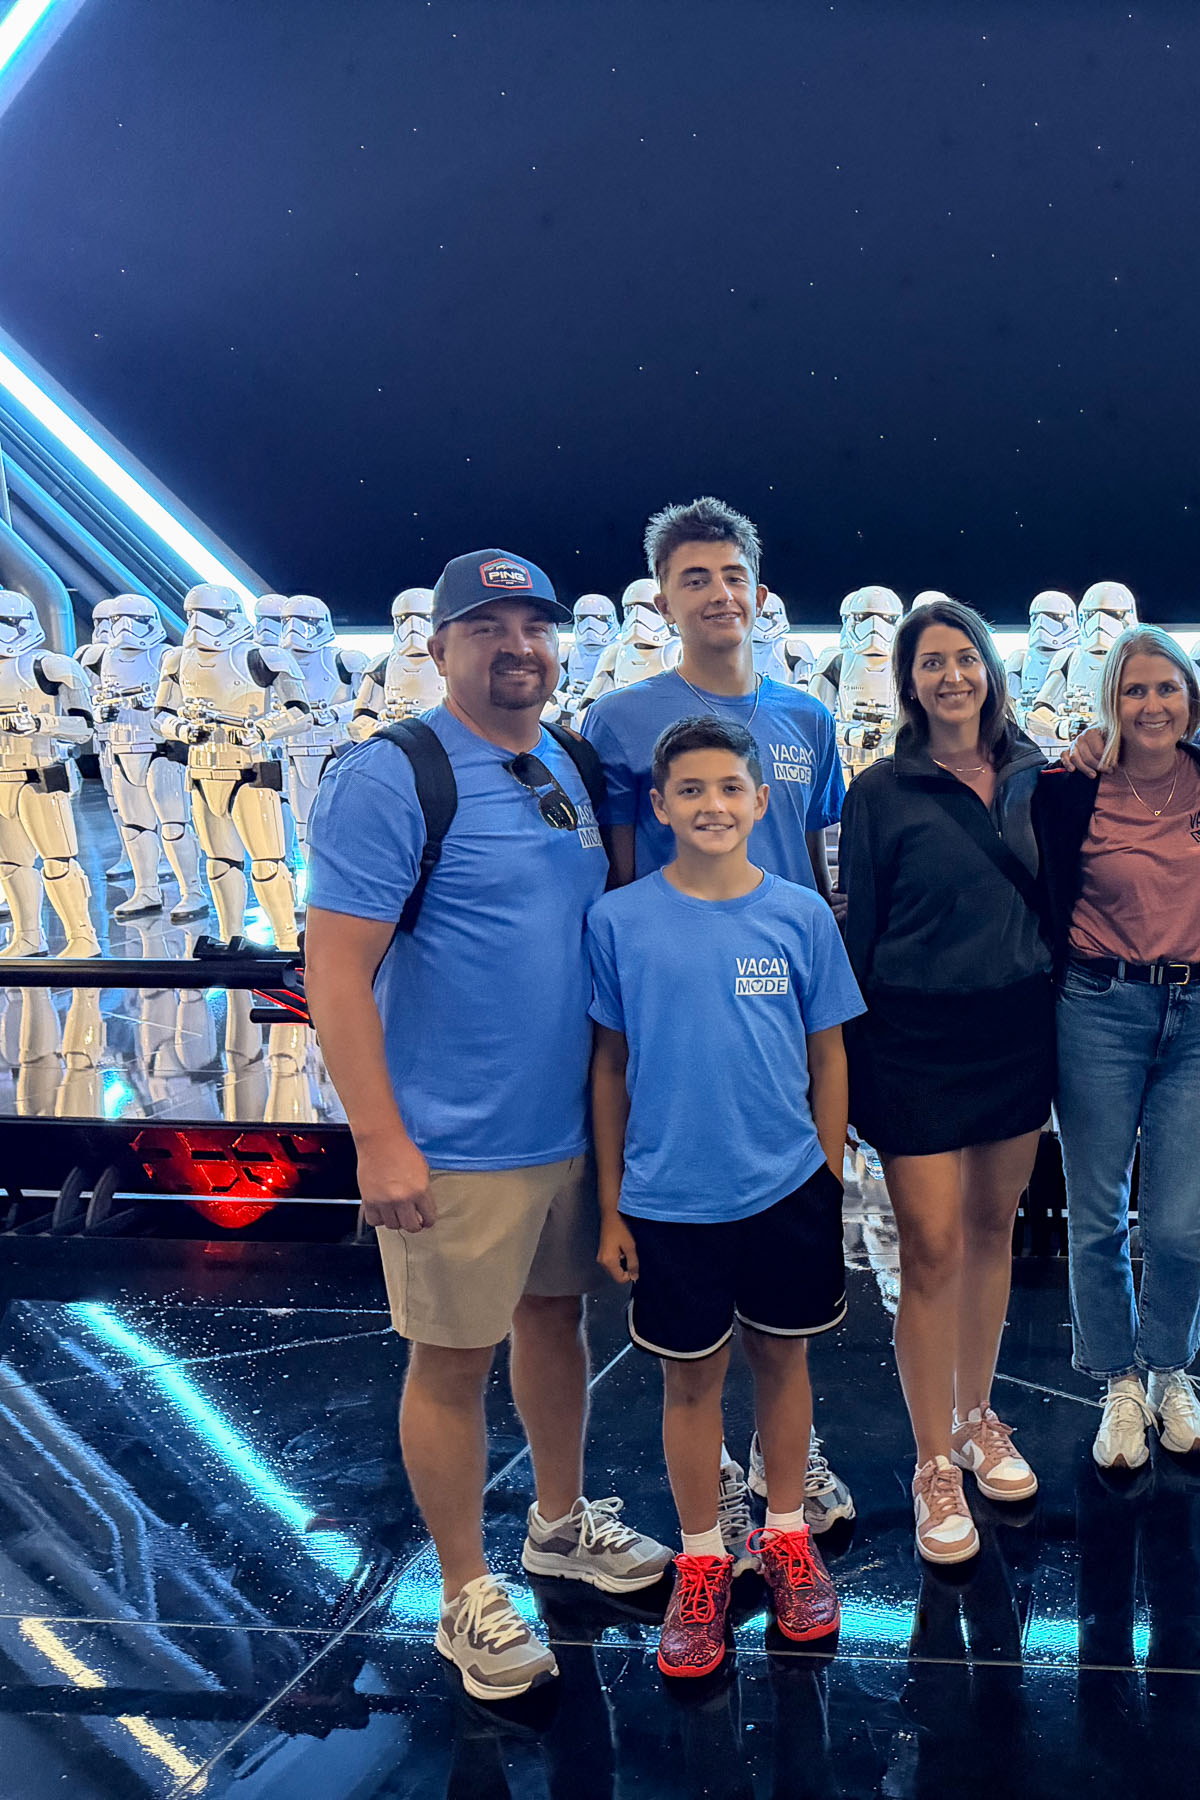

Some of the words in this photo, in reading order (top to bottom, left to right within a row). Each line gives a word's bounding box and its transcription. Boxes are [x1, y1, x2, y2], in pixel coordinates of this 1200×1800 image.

[488, 571, 525, 582] PING
[769, 743, 813, 765] VACAY
[776, 764, 811, 783] MODE
[736, 957, 788, 976] VACAY
[737, 979, 787, 993] MODE
